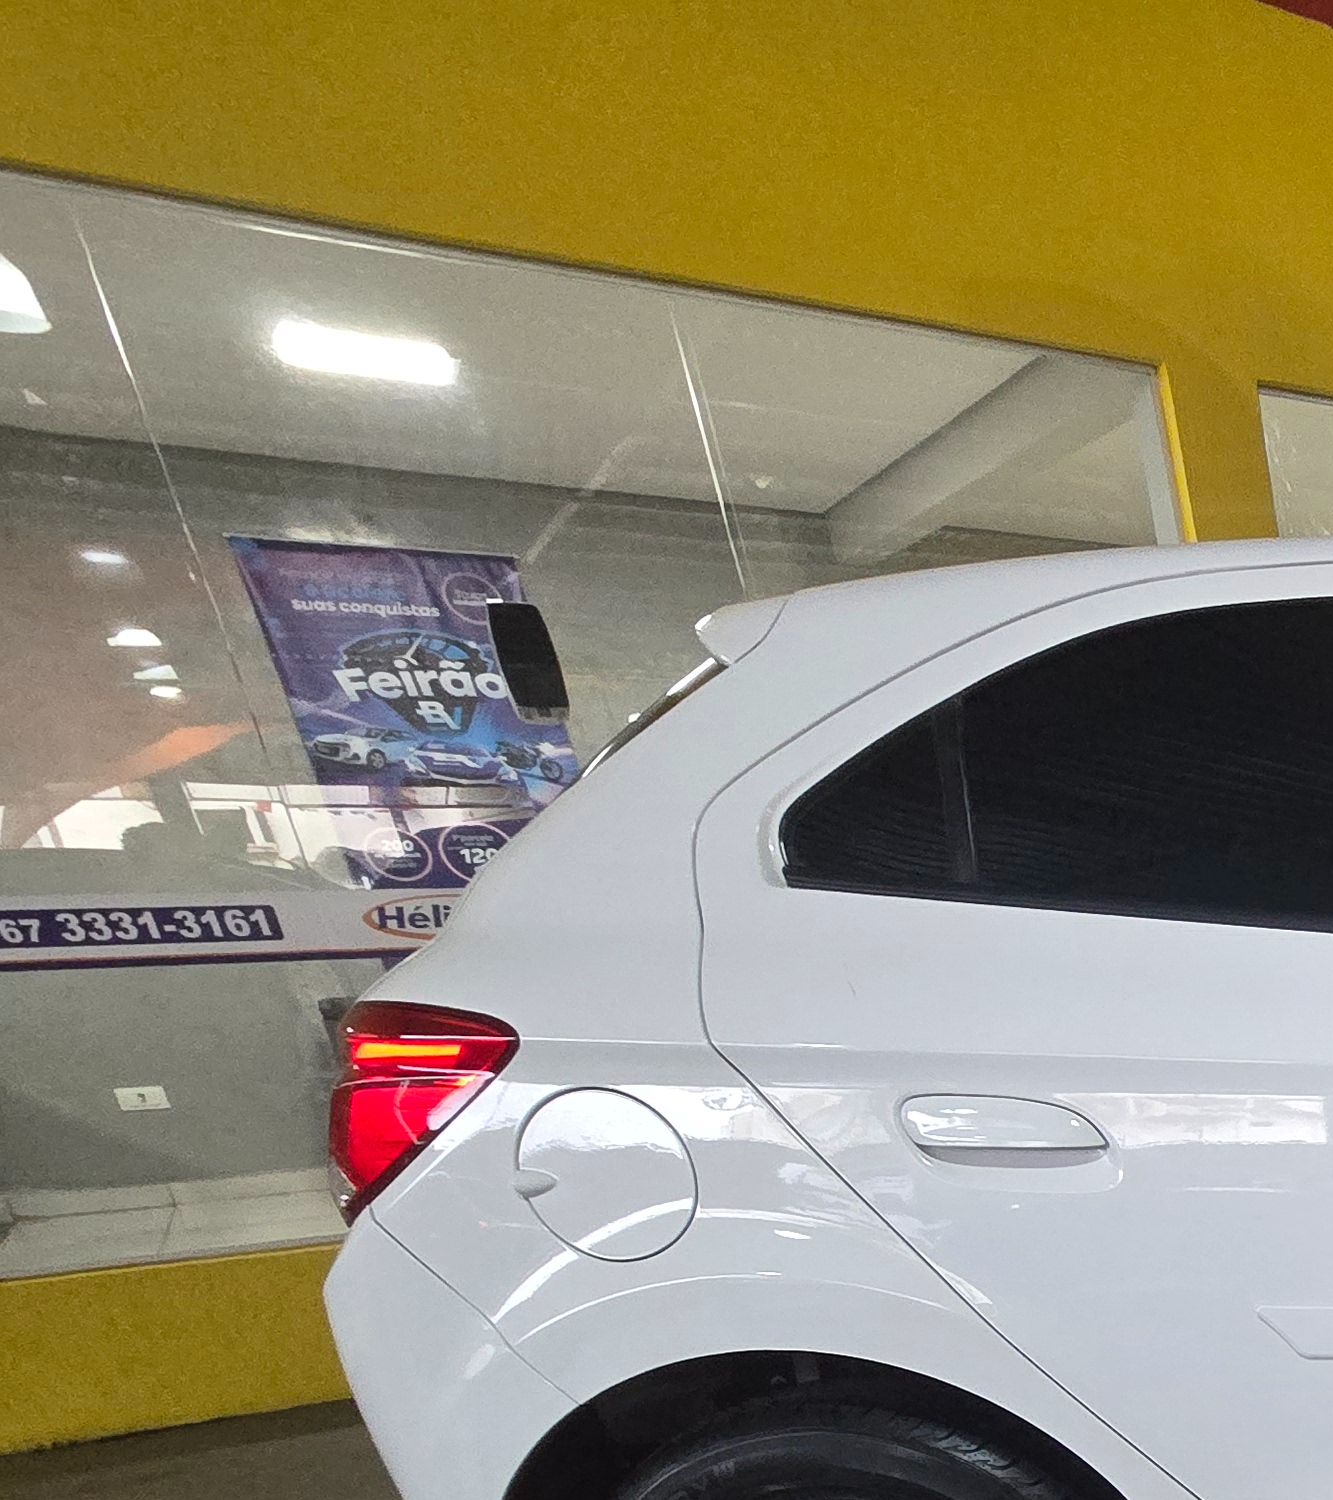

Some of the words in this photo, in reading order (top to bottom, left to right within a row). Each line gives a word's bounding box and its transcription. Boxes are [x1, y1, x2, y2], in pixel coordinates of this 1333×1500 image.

[291, 598, 337, 612] suas
[338, 601, 441, 618] conquistas
[331, 659, 510, 703] Feirão
[0, 918, 40, 943] 67
[55, 908, 273, 942] 3331-3161
